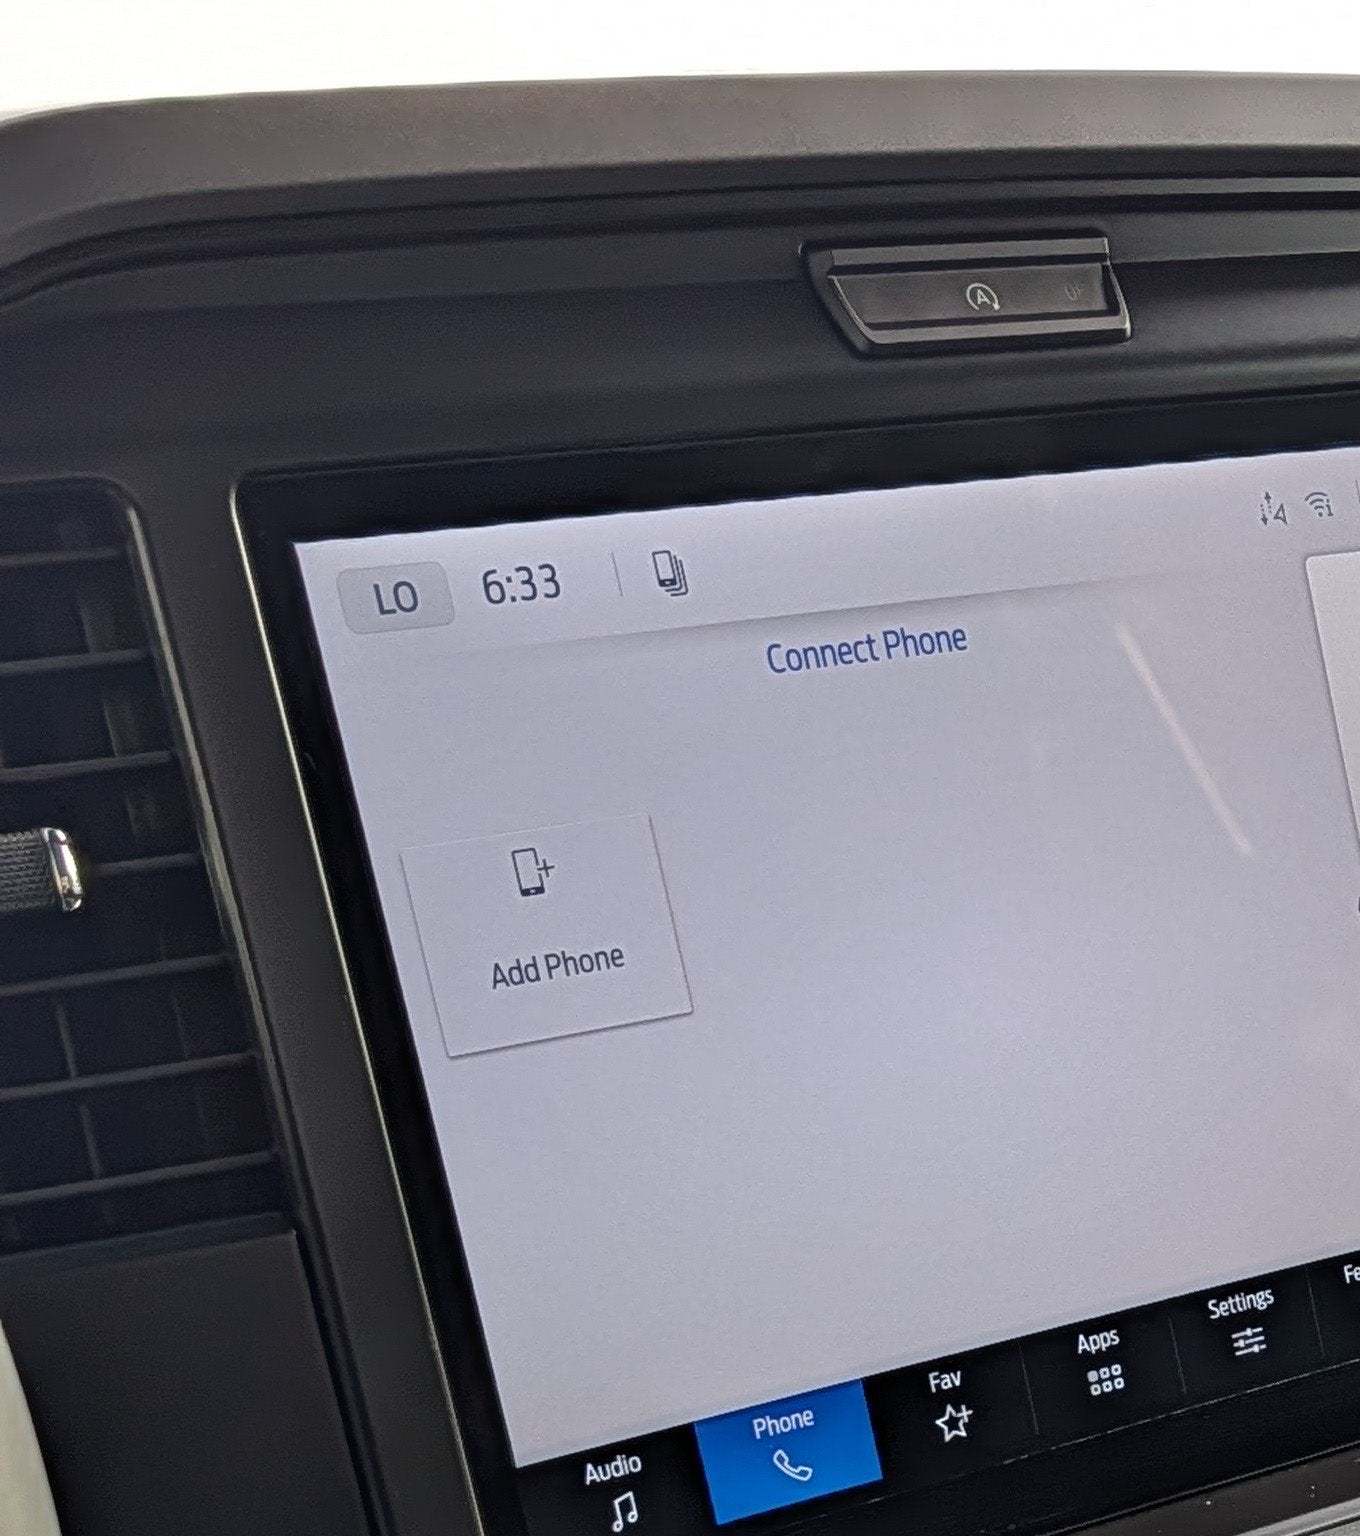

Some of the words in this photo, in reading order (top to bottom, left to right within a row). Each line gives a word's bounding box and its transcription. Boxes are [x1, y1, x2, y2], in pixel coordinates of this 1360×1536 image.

[374, 581, 418, 615] LO
[483, 564, 560, 604] 6:33
[767, 632, 879, 674] Connect
[883, 626, 968, 661] Phone
[491, 956, 540, 990] Add
[545, 949, 625, 981] Phone
[1208, 1287, 1275, 1320] Settings
[1077, 1329, 1120, 1354] Apps
[929, 1371, 960, 1392] Fav
[753, 1407, 815, 1439] Phone
[585, 1453, 642, 1485] Audio
